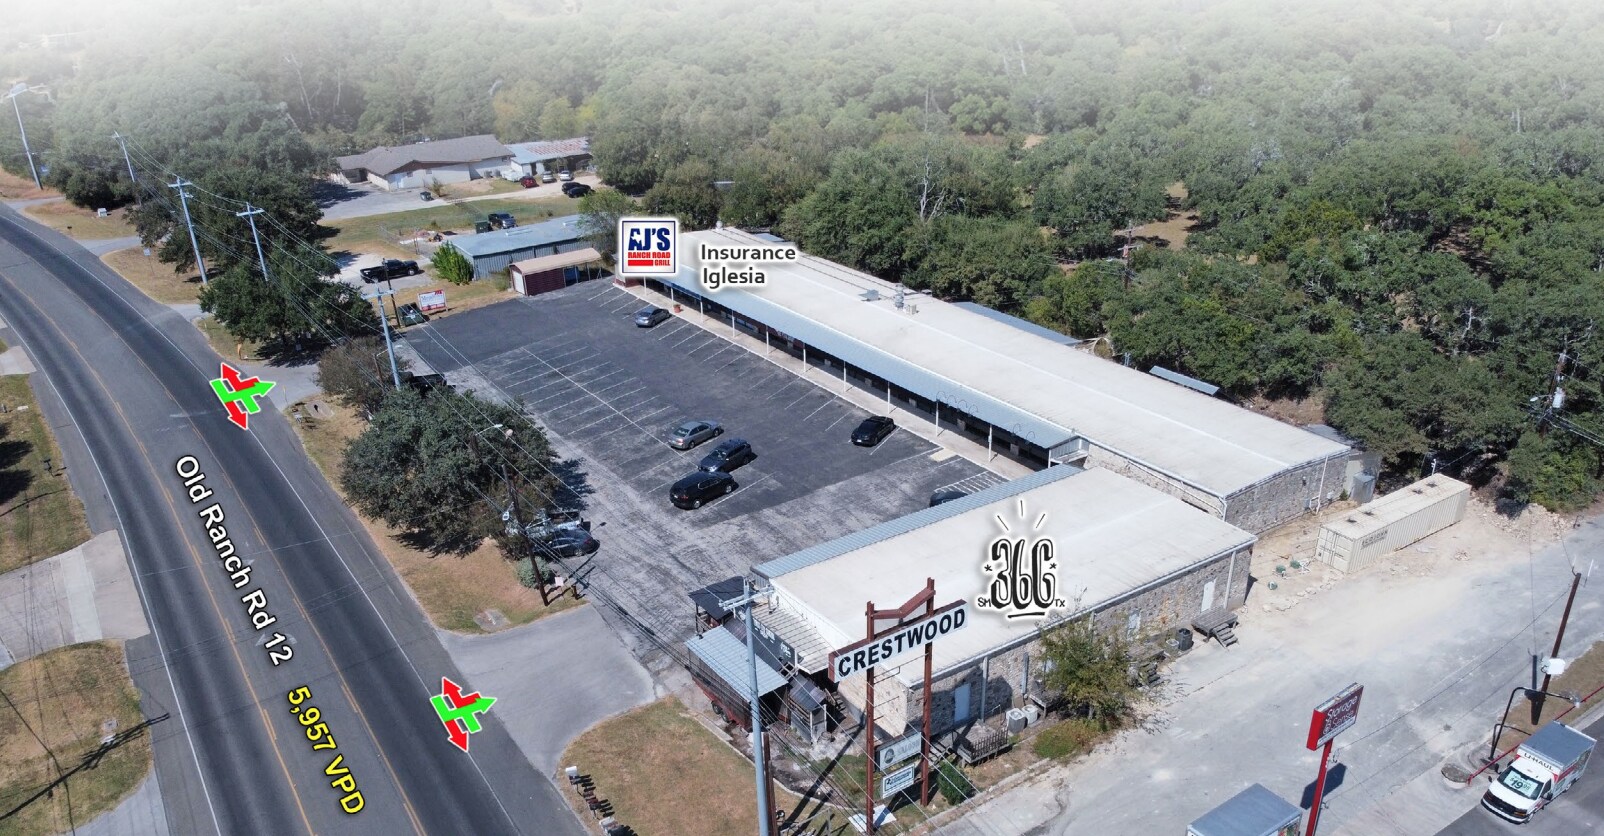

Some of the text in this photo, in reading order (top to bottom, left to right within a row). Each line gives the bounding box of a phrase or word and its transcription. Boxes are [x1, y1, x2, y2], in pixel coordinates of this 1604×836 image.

[838, 608, 966, 678] CRESTWOOD
[1327, 695, 1358, 717] Storage
[1524, 752, 1554, 771] U-HAUL
